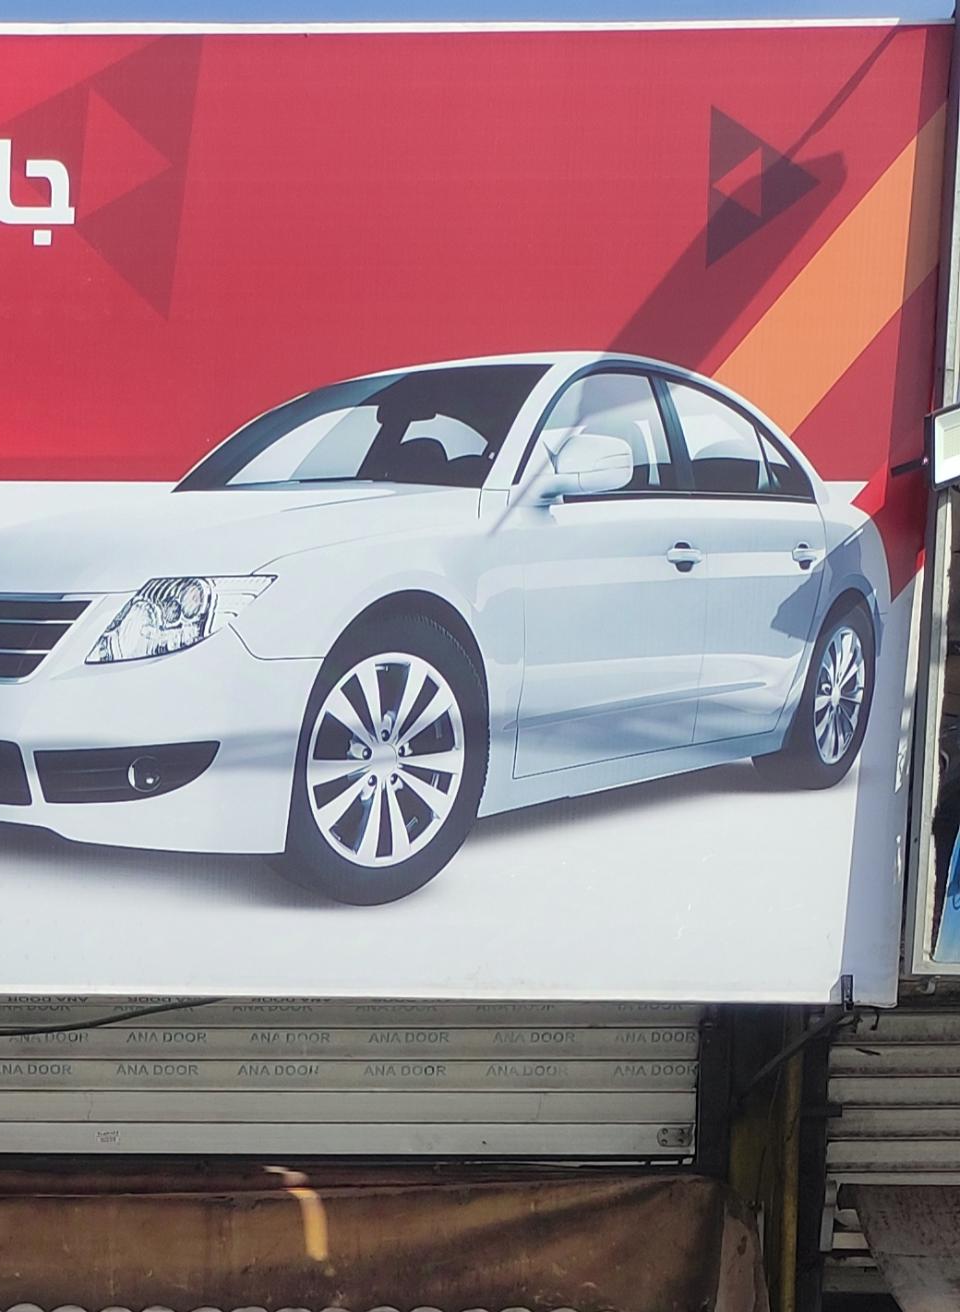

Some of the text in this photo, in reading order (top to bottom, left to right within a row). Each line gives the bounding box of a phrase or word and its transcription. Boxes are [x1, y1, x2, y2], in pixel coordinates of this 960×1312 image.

[47, 1032, 89, 1043] DOOR
[126, 1032, 207, 1043] ANA DOOR
[251, 1032, 330, 1043] ANA DOOR
[368, 1032, 449, 1043] ANA DOOR
[494, 1032, 575, 1043] ANA DOOR
[614, 1032, 696, 1043] ANA DOOR
[28, 1064, 72, 1075] DOOR
[117, 1064, 199, 1075] ANA DOOR
[238, 1064, 319, 1076] ANA DOOR
[364, 1065, 446, 1076] ANA DOOR
[487, 1065, 568, 1076] ANA DOOR
[614, 1065, 698, 1076] ANA DOOR
